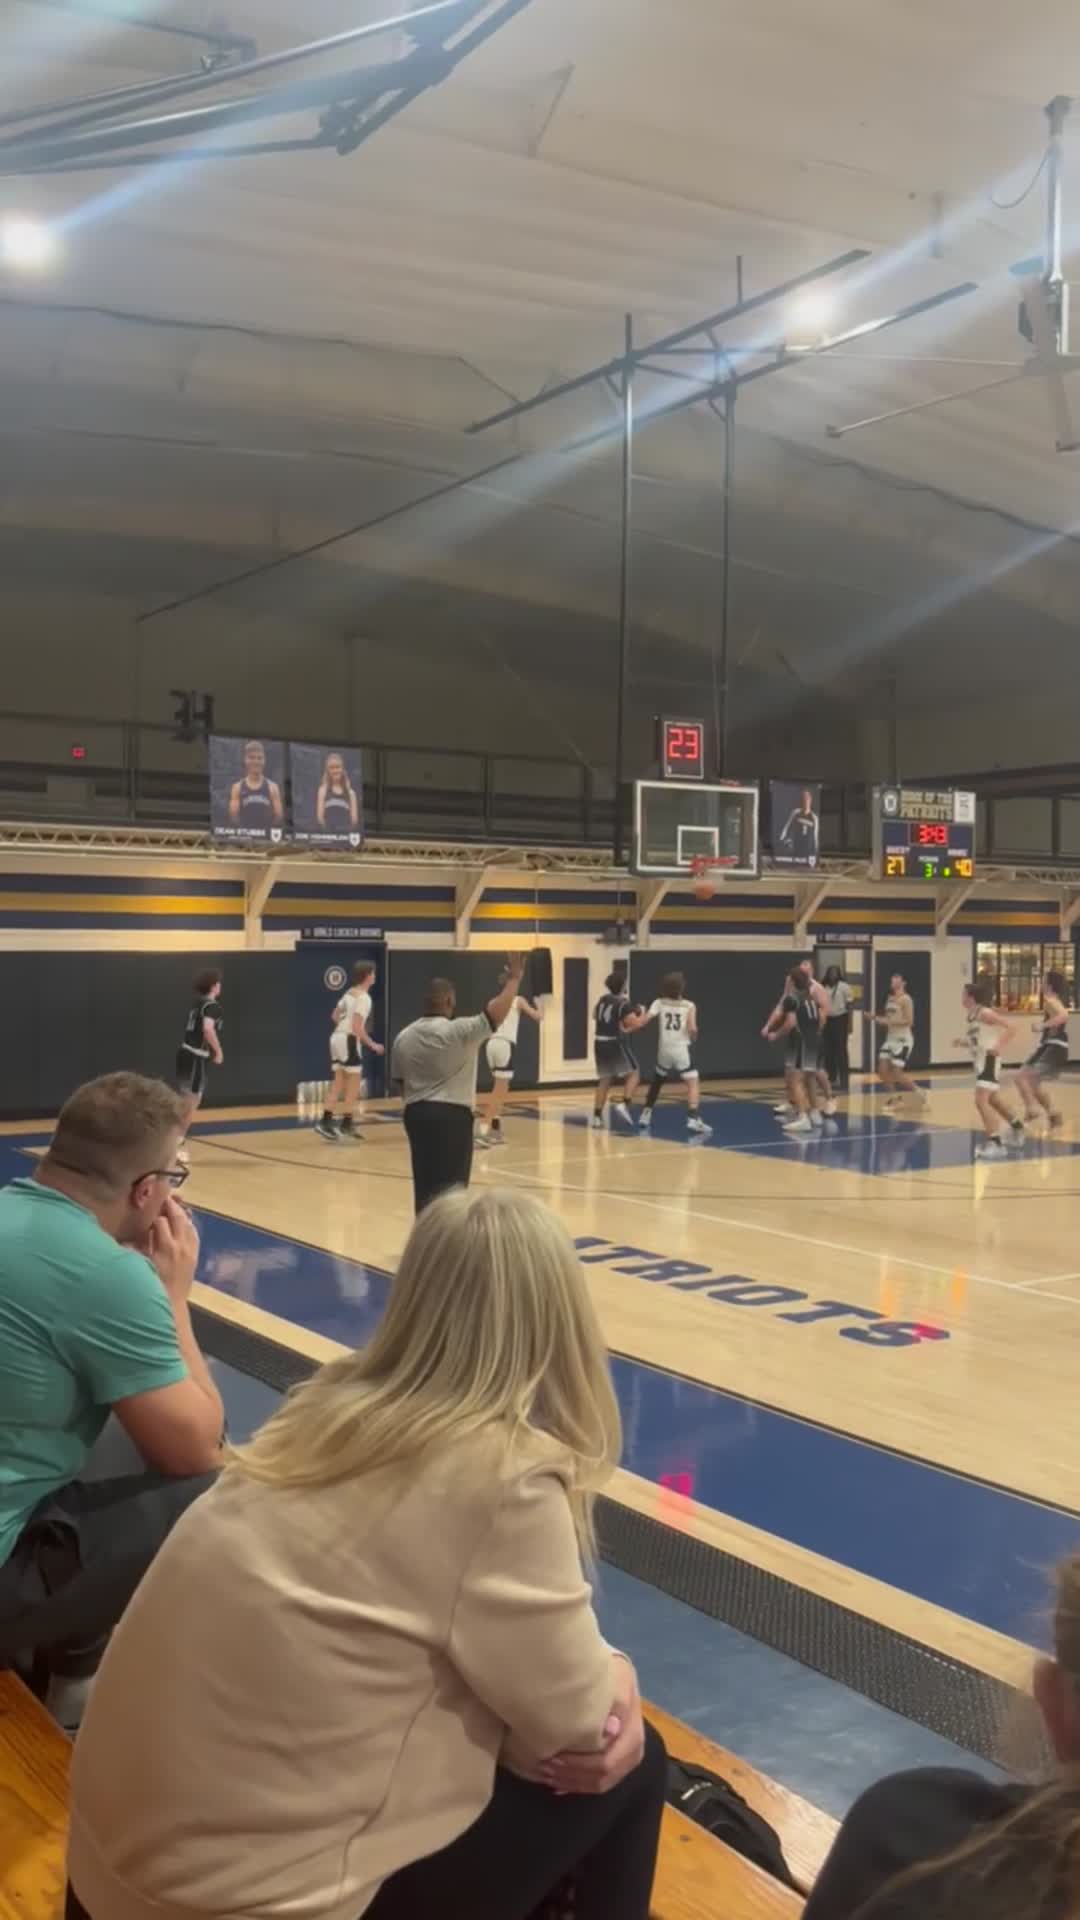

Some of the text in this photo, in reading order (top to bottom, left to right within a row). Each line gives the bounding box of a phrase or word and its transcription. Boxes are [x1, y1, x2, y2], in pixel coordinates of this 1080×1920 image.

[669, 728, 699, 759] 23
[886, 856, 905, 875] 27
[924, 863, 934, 878] 3
[955, 858, 973, 877] 40
[664, 1012, 682, 1031] 23
